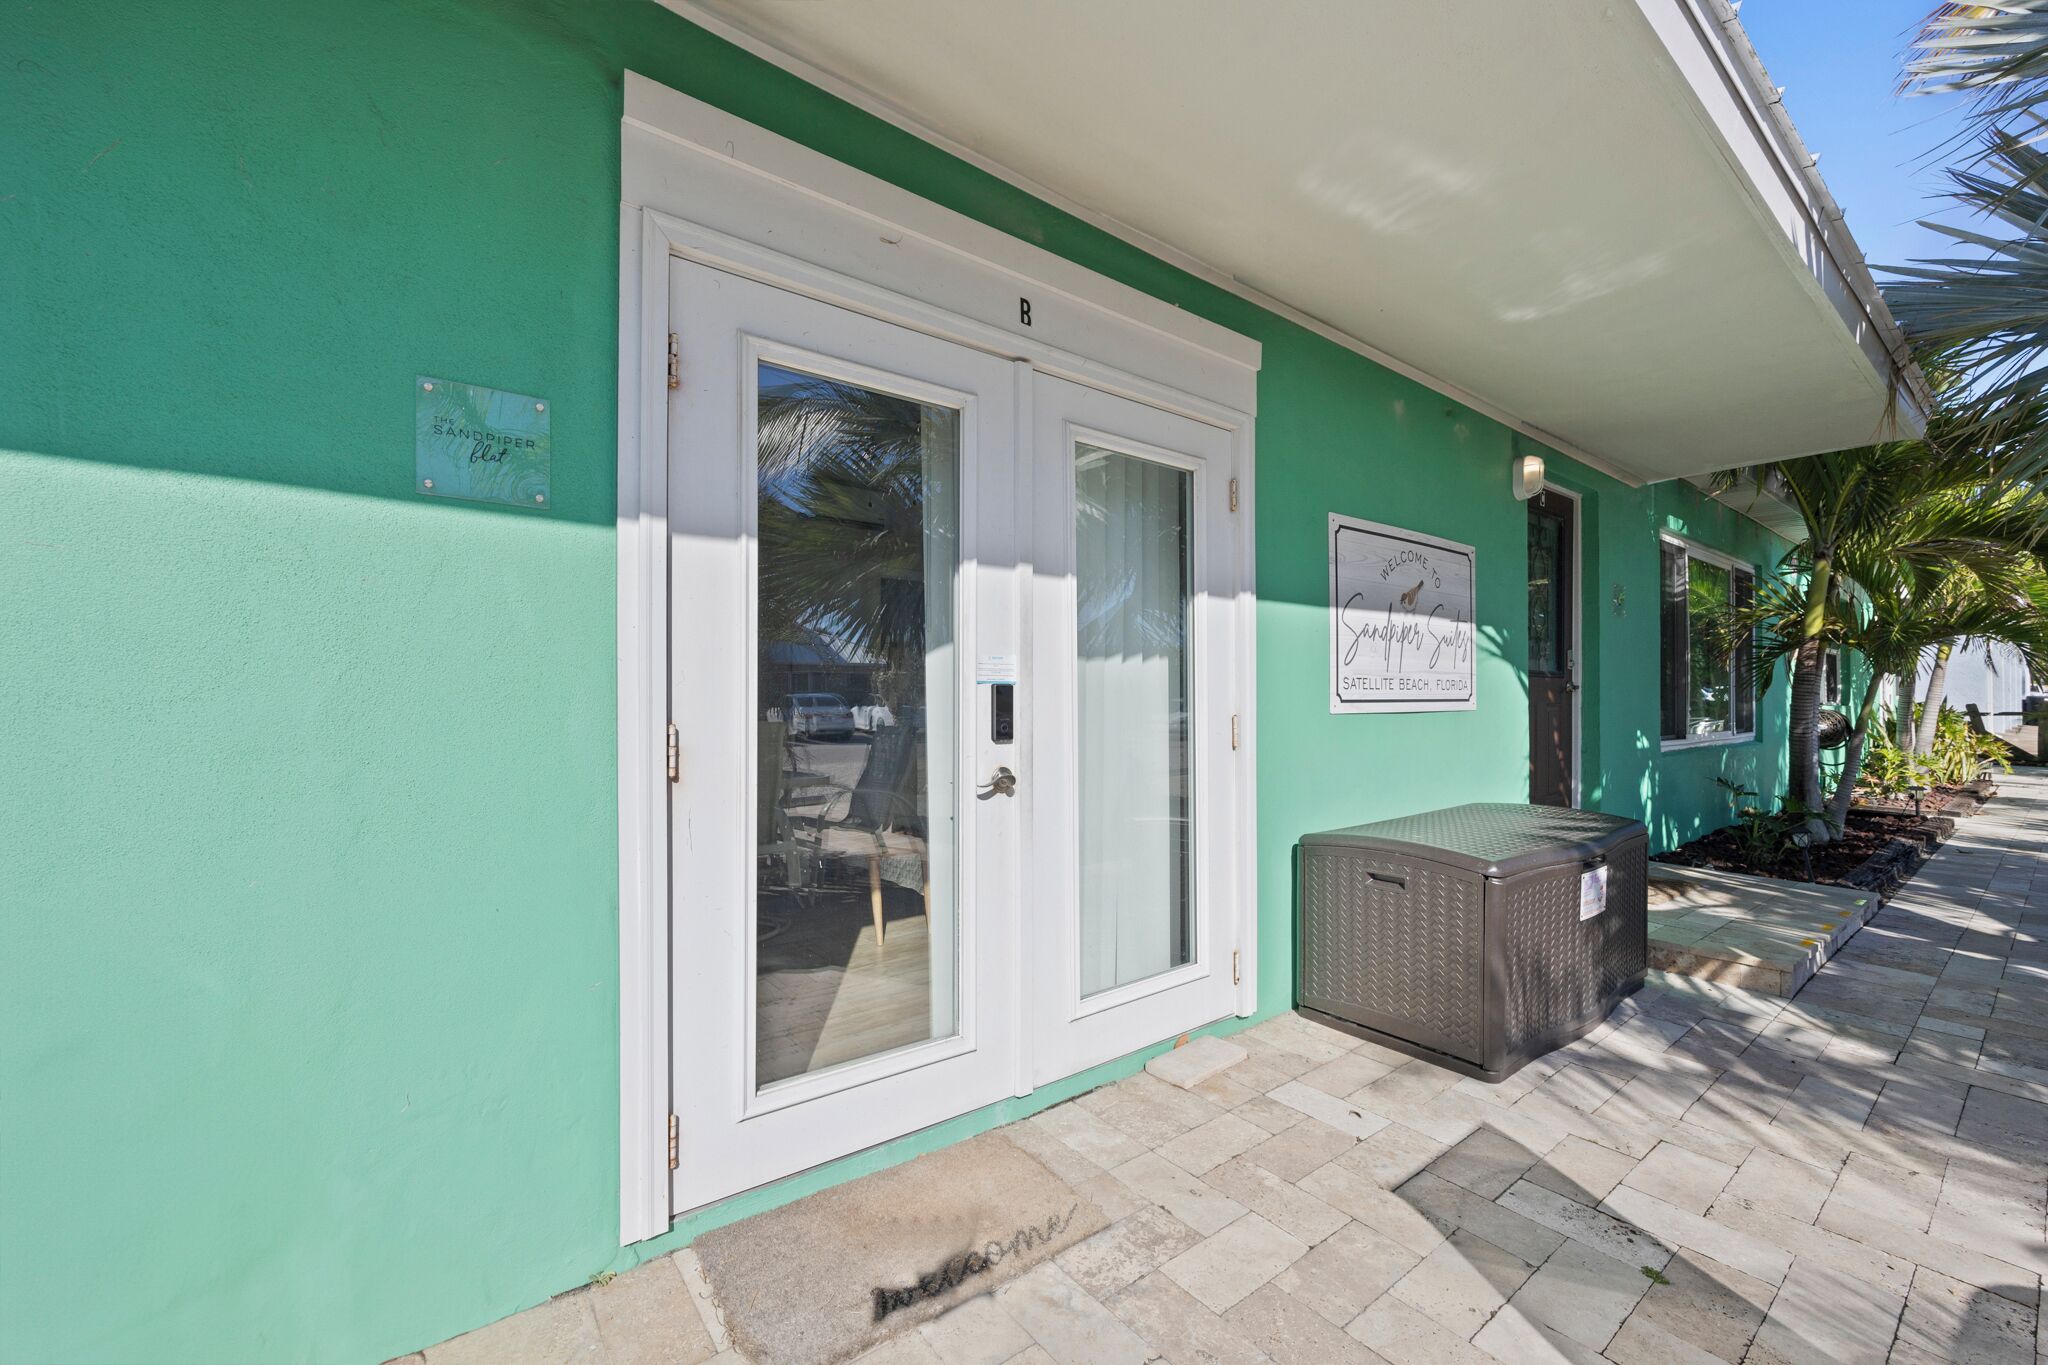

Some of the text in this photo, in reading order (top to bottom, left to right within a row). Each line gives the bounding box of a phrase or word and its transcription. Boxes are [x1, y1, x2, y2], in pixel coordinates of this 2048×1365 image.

[1020, 297, 1031, 327] B
[434, 415, 454, 426] THE
[433, 424, 535, 449] SANDPIPER
[470, 441, 508, 464] flat
[1380, 550, 1440, 589] WELCOME TO
[1341, 592, 1470, 673] Sandpiper Suites
[1343, 677, 1395, 690] SATELLITE
[1436, 679, 1468, 691] FLORIDA
